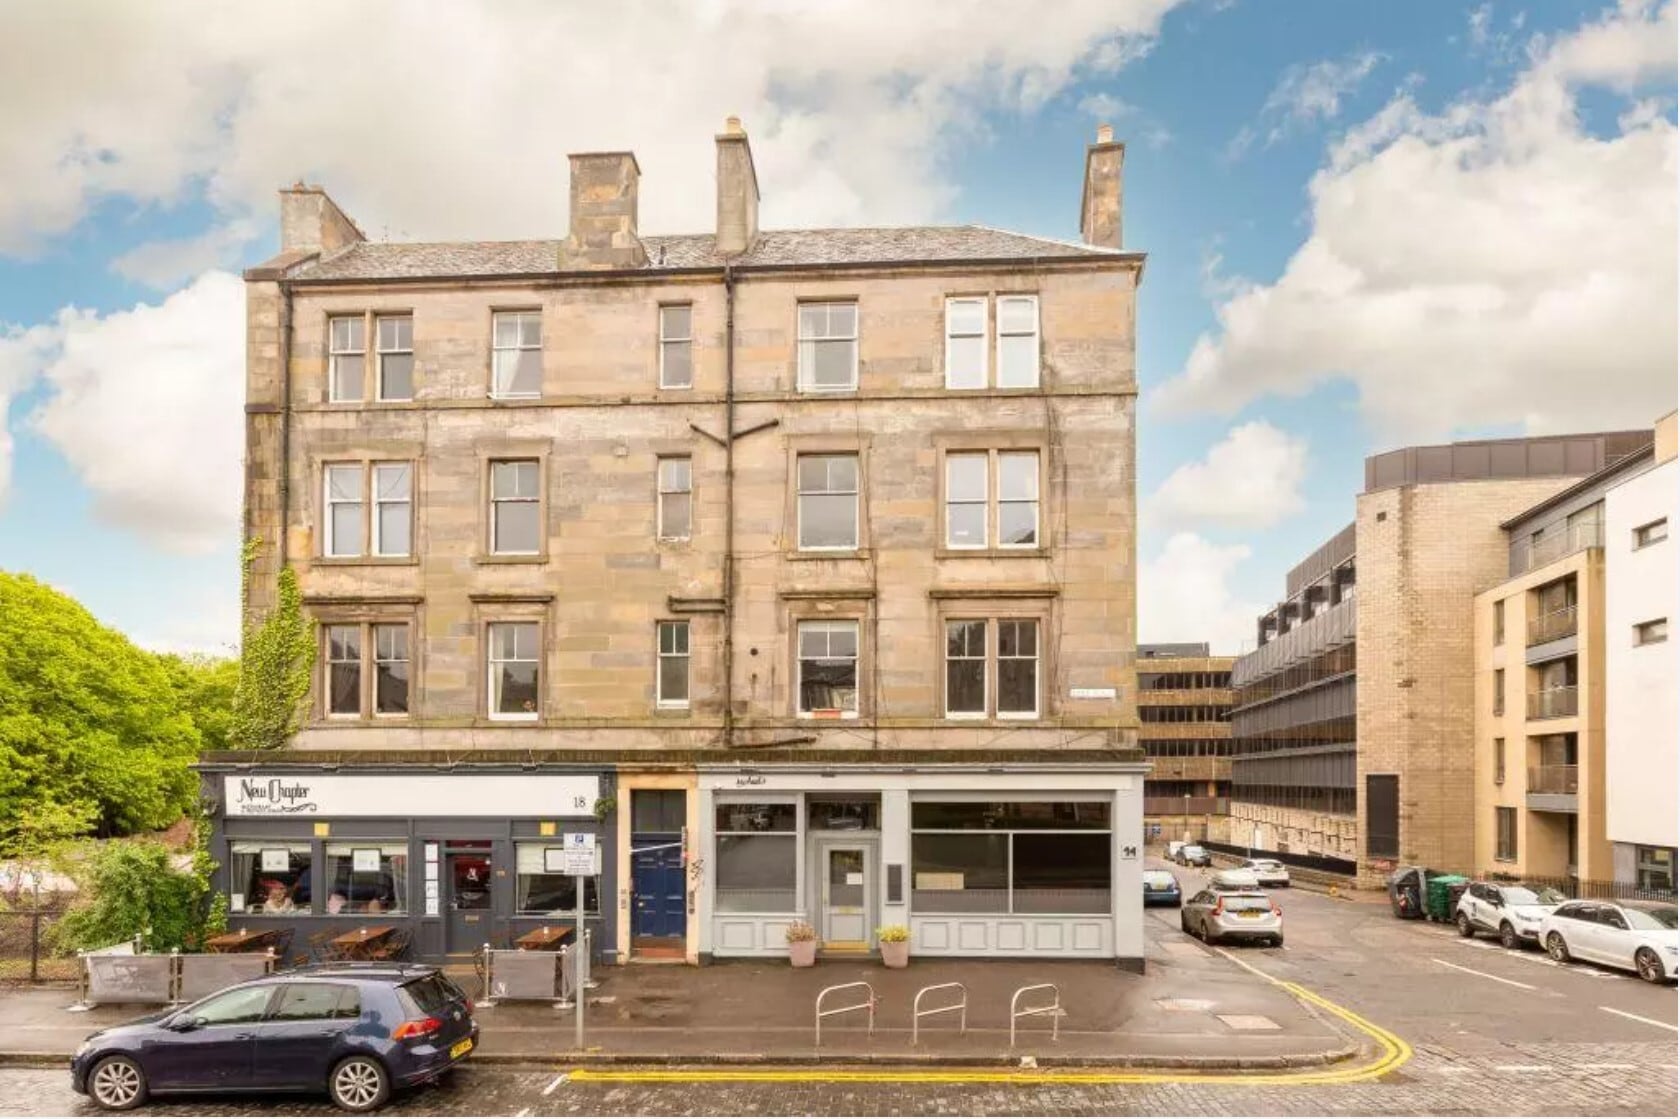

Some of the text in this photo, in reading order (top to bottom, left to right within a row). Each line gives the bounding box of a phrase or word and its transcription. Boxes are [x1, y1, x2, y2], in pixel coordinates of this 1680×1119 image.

[236, 779, 310, 804] New Chapter
[574, 796, 586, 808] 18
